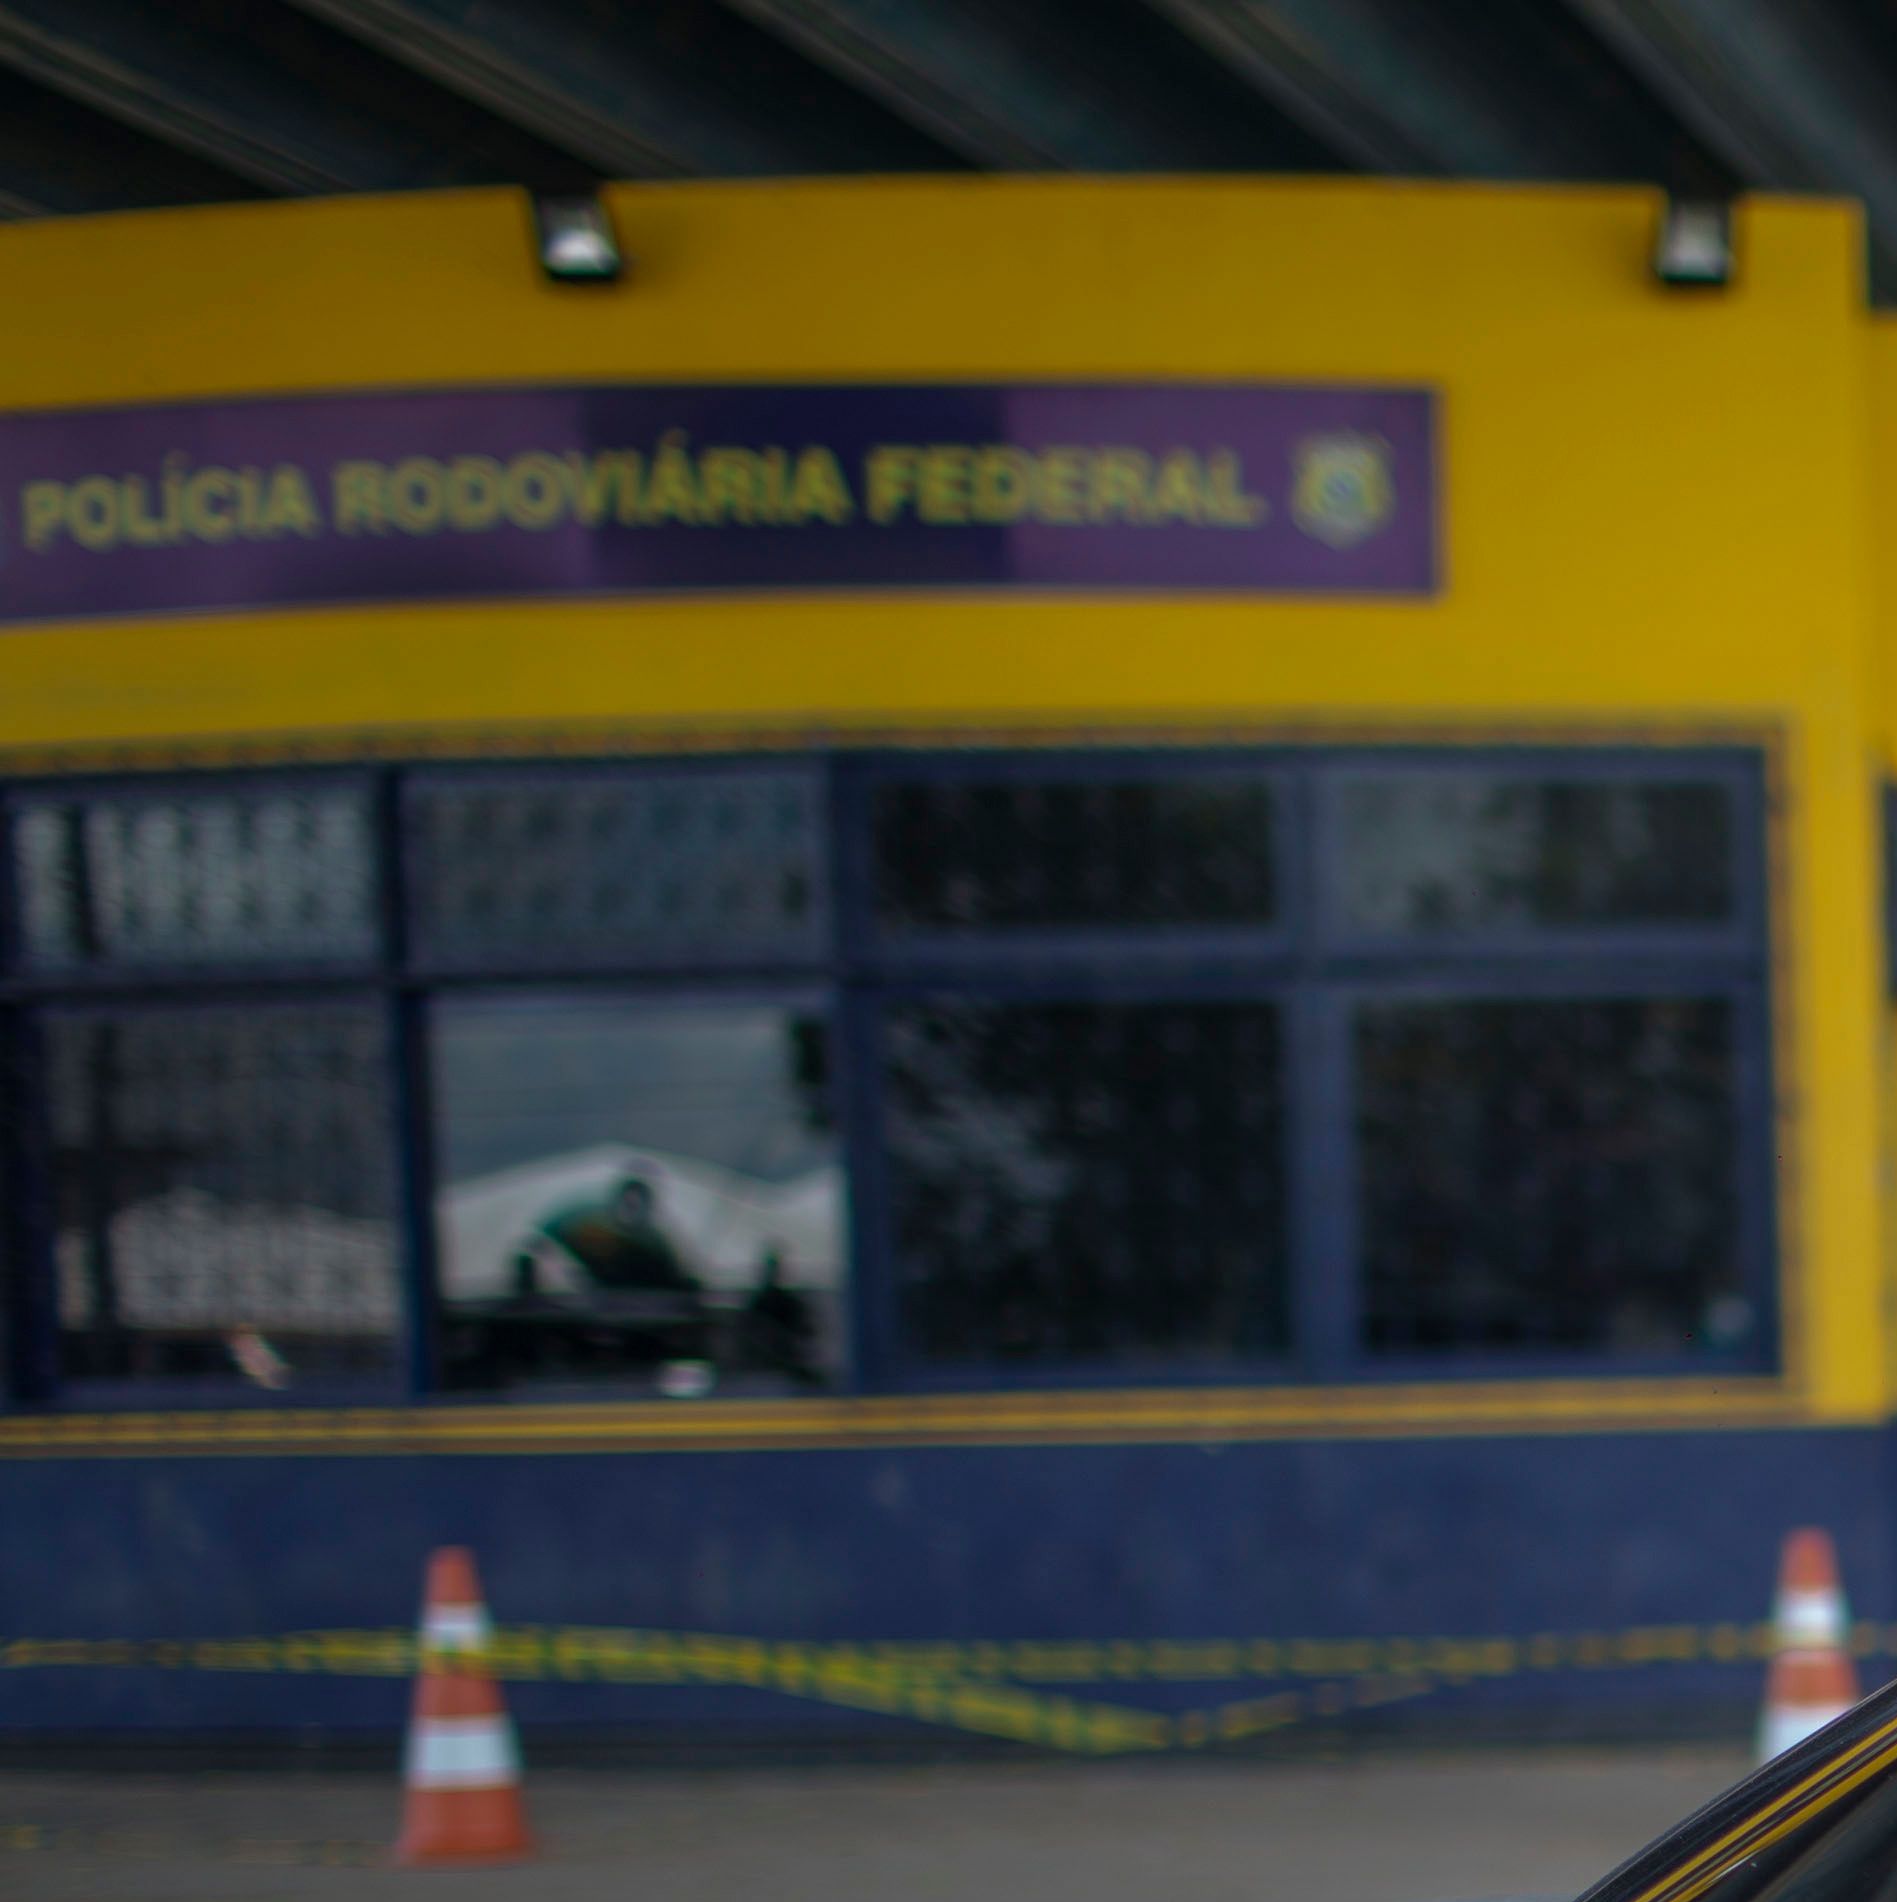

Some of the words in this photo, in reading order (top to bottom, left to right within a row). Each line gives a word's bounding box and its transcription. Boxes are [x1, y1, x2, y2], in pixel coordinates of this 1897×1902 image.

[24, 452, 314, 550] POLÍCIA
[337, 430, 848, 532] RODOVIÁRIA
[868, 446, 1262, 528] FEDERAL
